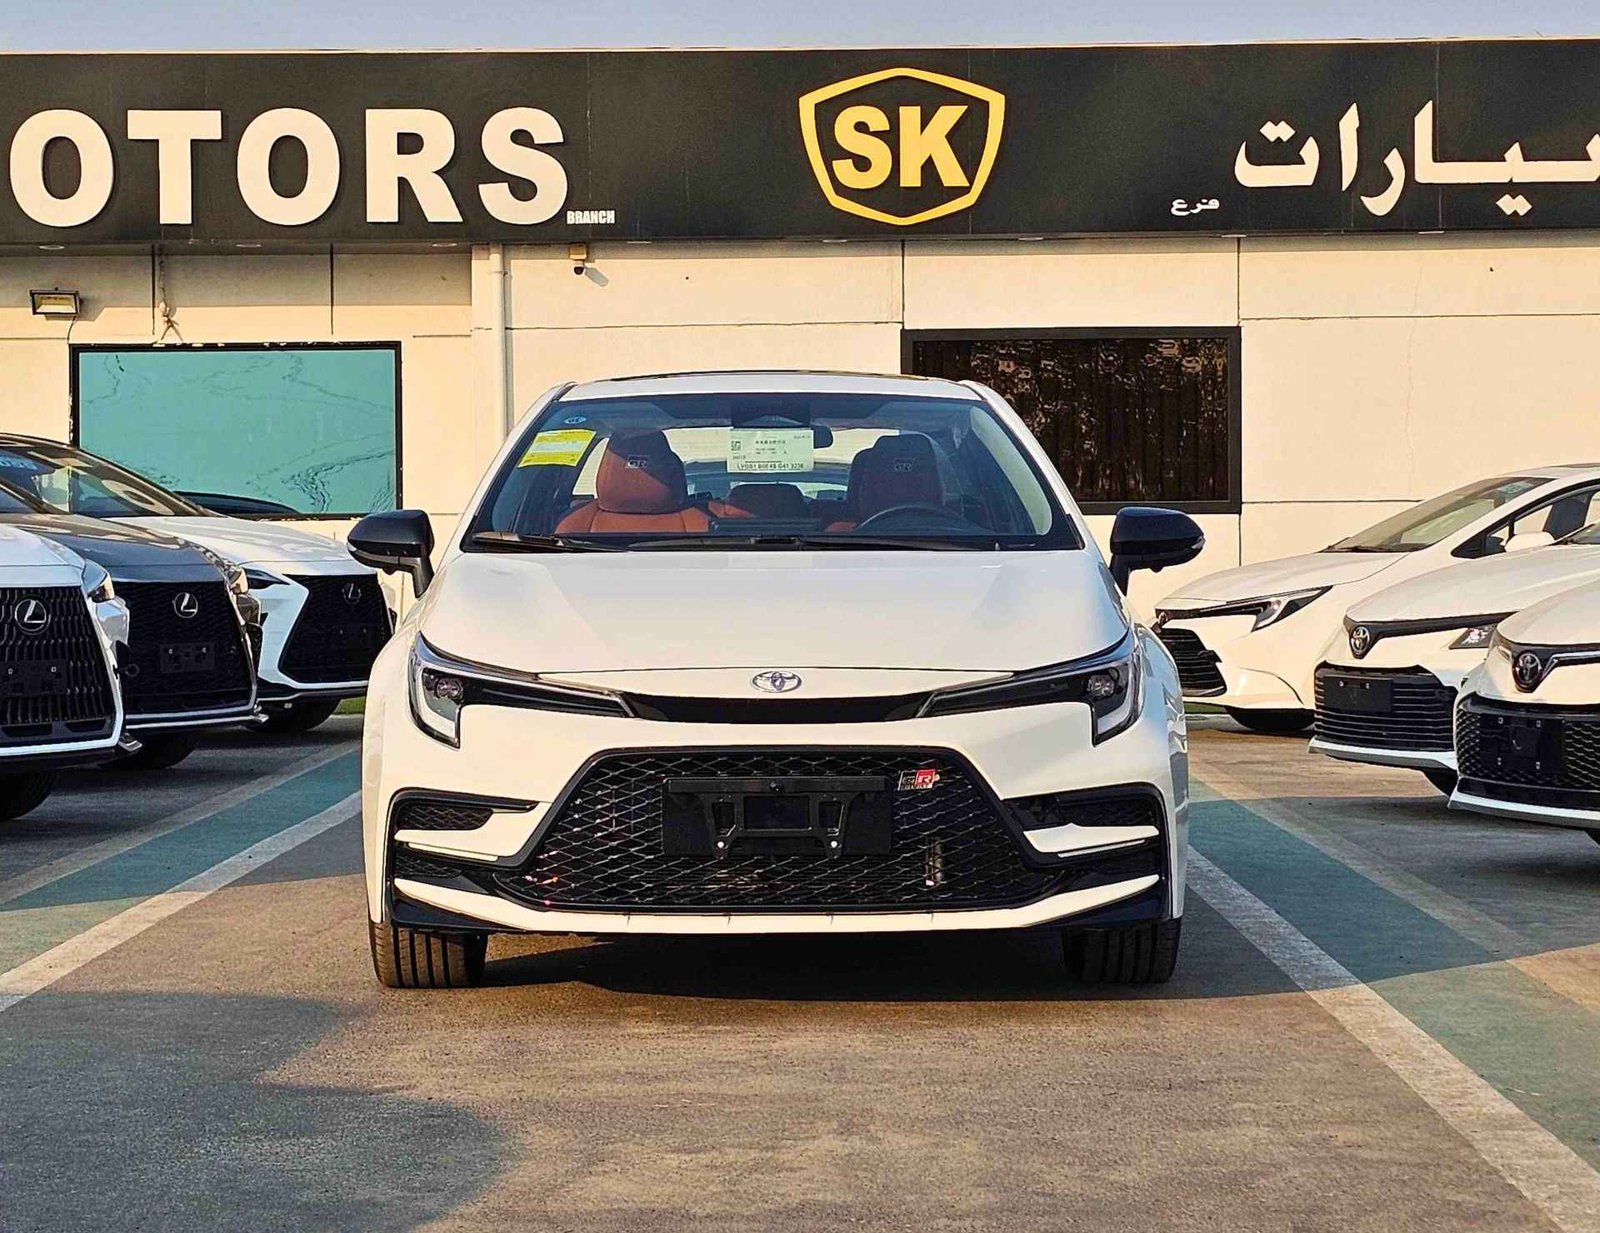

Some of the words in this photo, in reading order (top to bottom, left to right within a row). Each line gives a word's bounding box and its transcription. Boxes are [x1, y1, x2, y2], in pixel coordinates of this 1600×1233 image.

[9, 106, 569, 227] OTORS
[832, 105, 970, 190] SK
[566, 210, 616, 225] BRANCH
[1170, 198, 1221, 217] فرع
